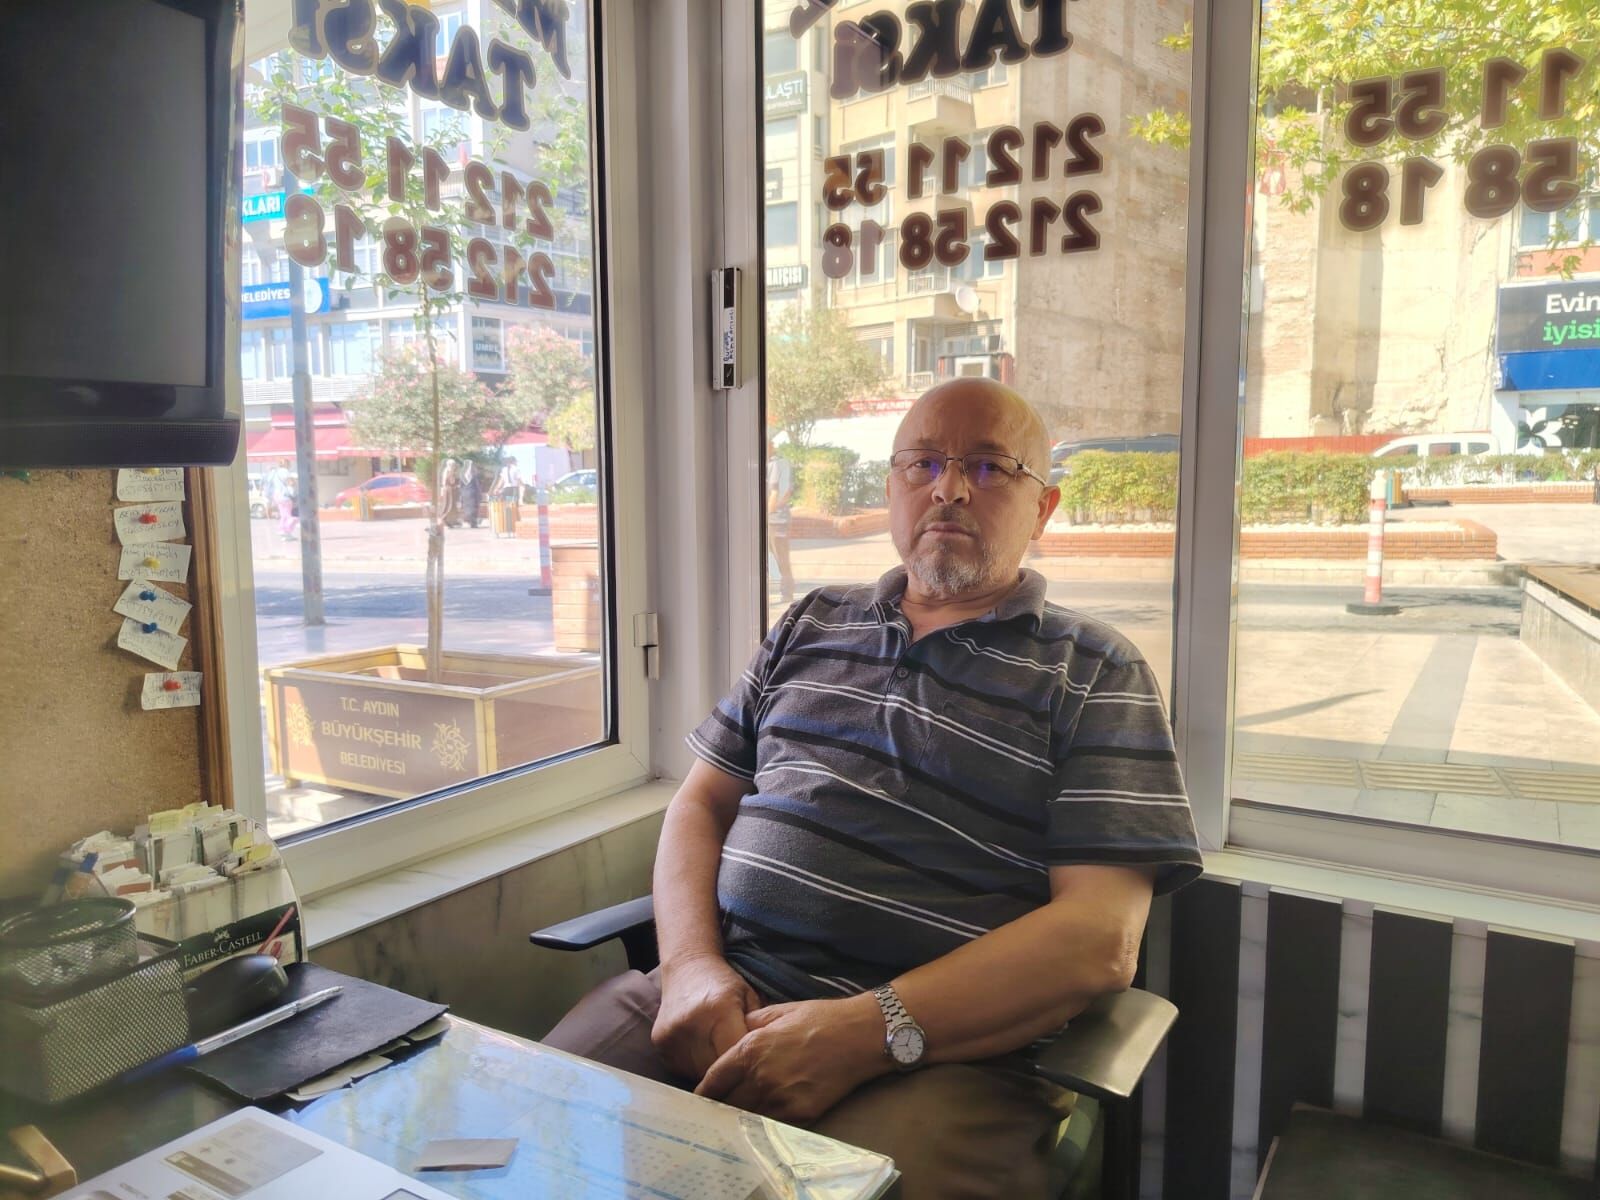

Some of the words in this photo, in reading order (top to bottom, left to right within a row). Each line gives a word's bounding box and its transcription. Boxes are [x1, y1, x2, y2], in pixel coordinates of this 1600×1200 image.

[1545, 291, 1600, 314] Evin
[1543, 318, 1600, 345] iyisi
[340, 697, 360, 712] T.C.
[363, 700, 399, 718] AYDIN
[321, 719, 422, 750] BÜYÜKŞEHİR
